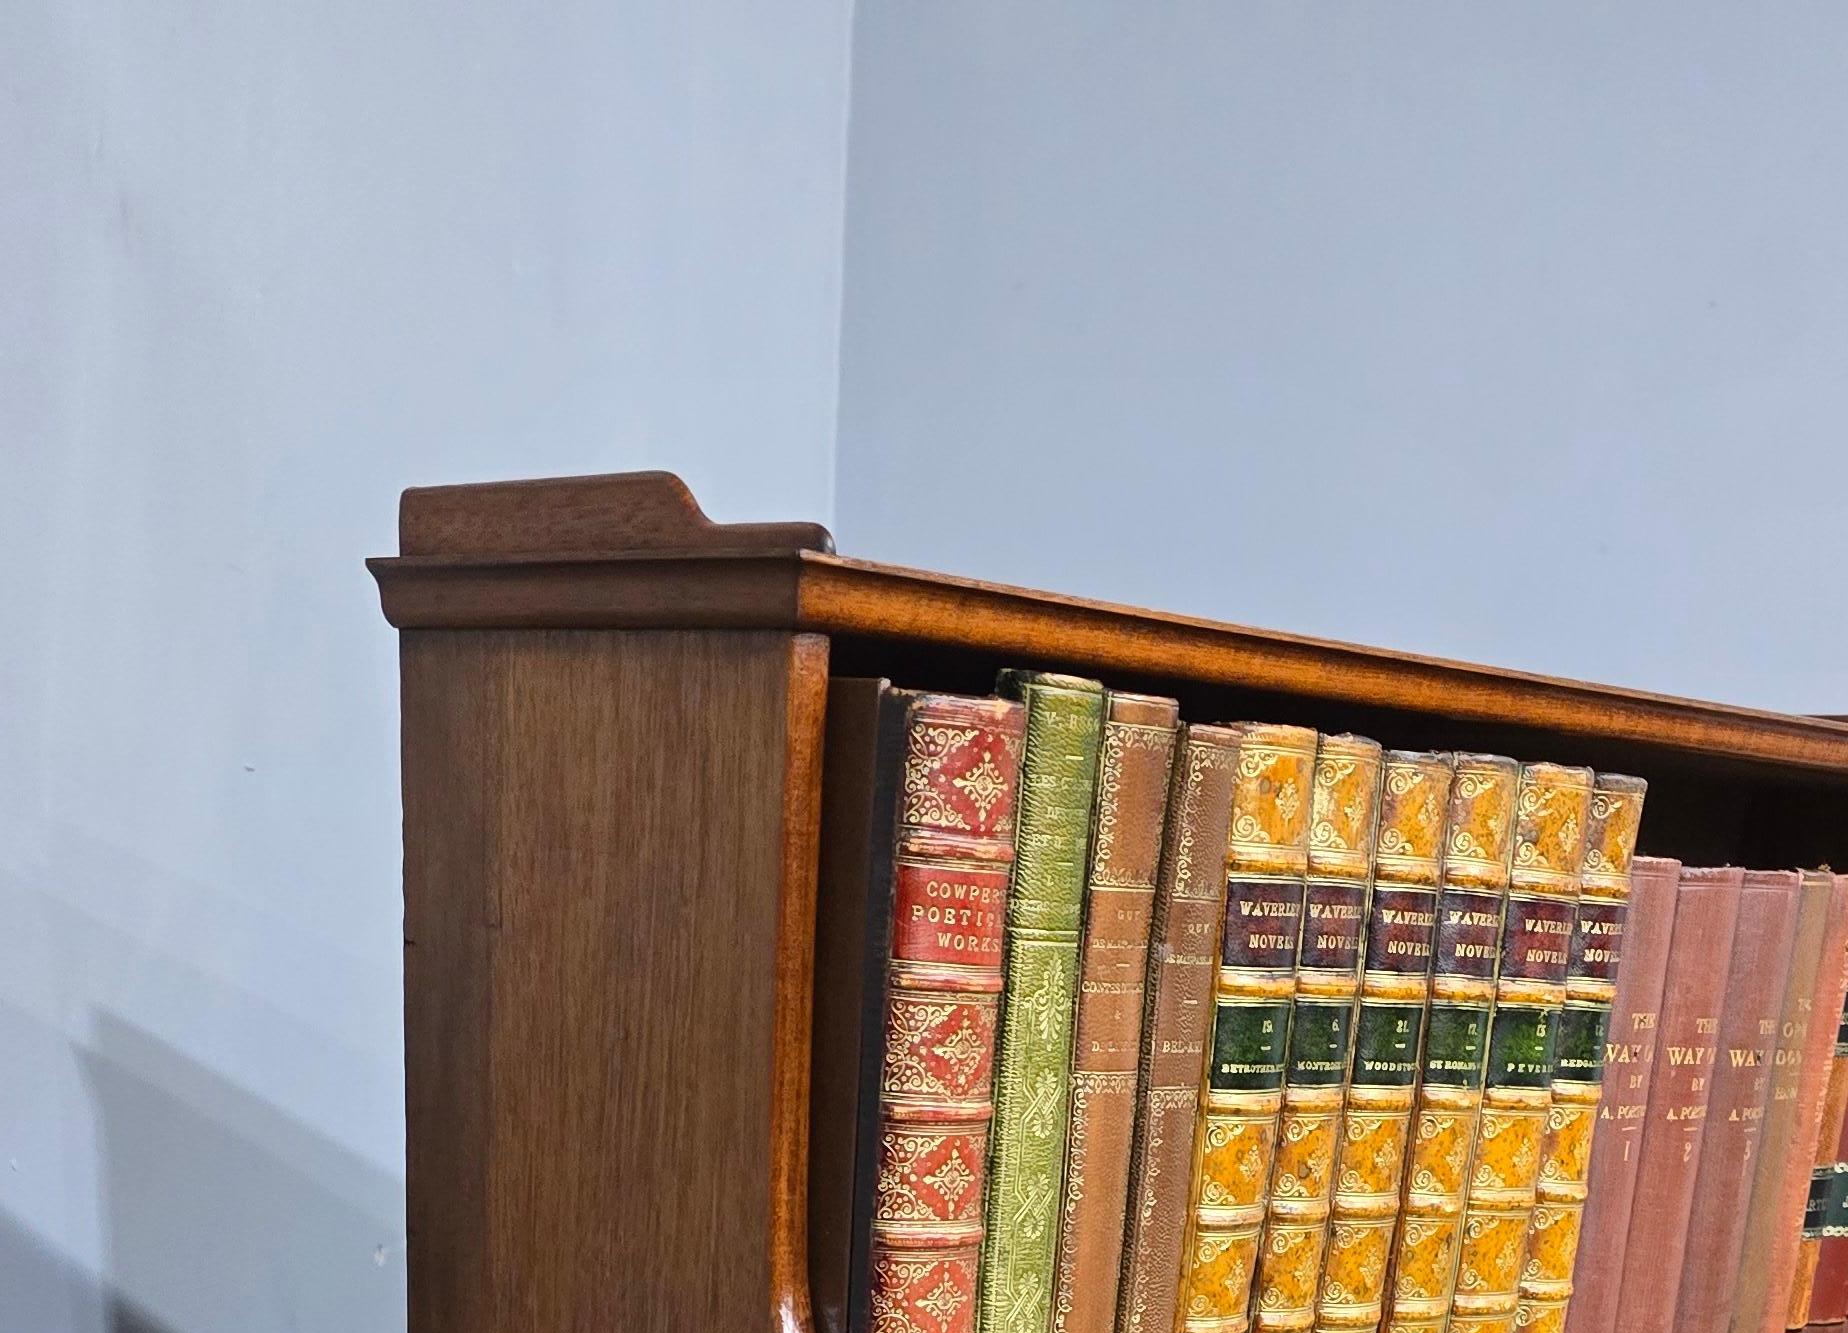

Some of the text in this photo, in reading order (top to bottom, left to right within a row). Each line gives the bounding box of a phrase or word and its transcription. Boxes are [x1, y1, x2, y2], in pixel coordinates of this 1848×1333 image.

[937, 932, 1000, 953] WORKS
[1667, 1047, 1705, 1066] WAY
[1691, 1077, 1706, 1092] BY
